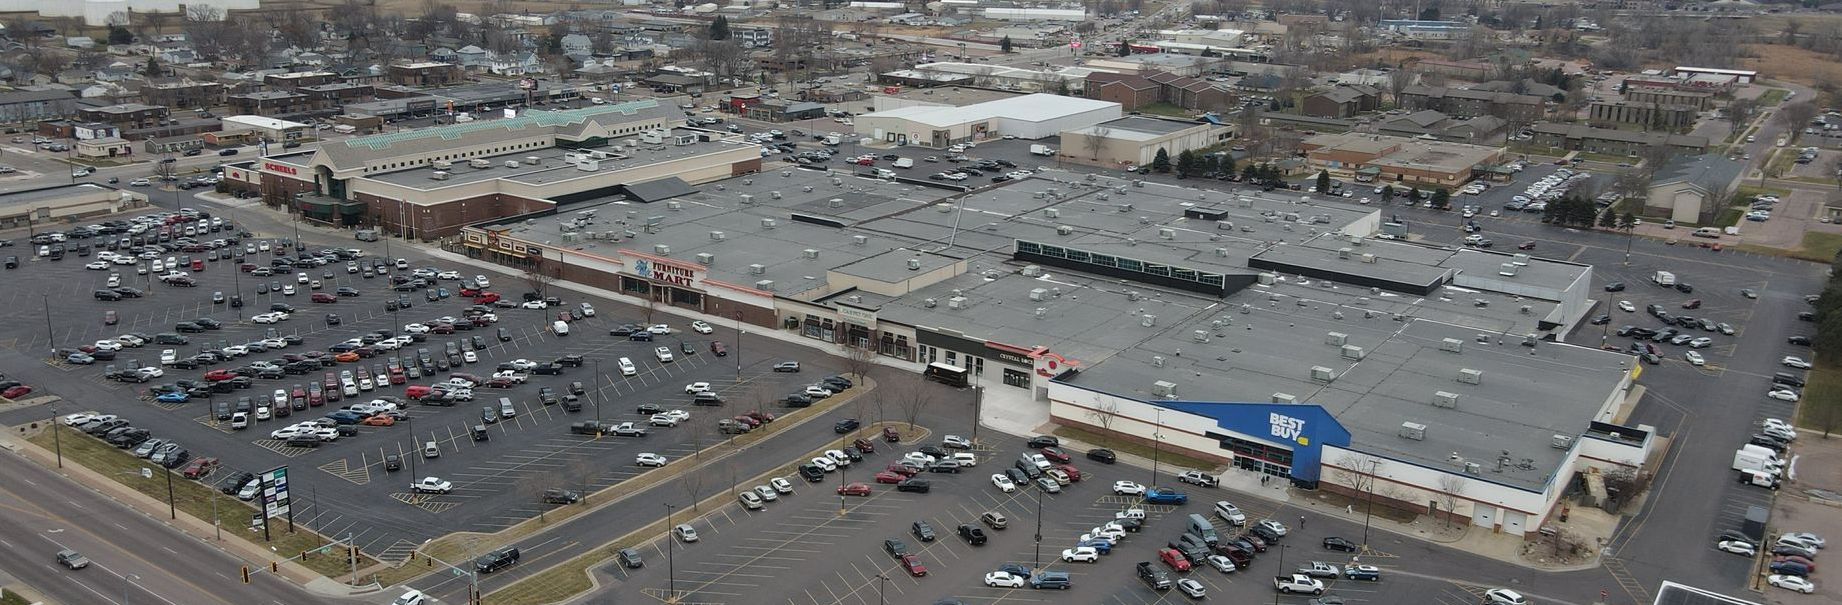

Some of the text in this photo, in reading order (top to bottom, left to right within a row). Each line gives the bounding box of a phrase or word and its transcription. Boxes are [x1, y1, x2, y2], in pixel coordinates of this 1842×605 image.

[265, 163, 296, 175] SCHEELS
[653, 262, 694, 277] FURNITURE
[653, 271, 693, 287] MART
[1270, 412, 1305, 431] BEST
[1271, 424, 1301, 442] BUY
